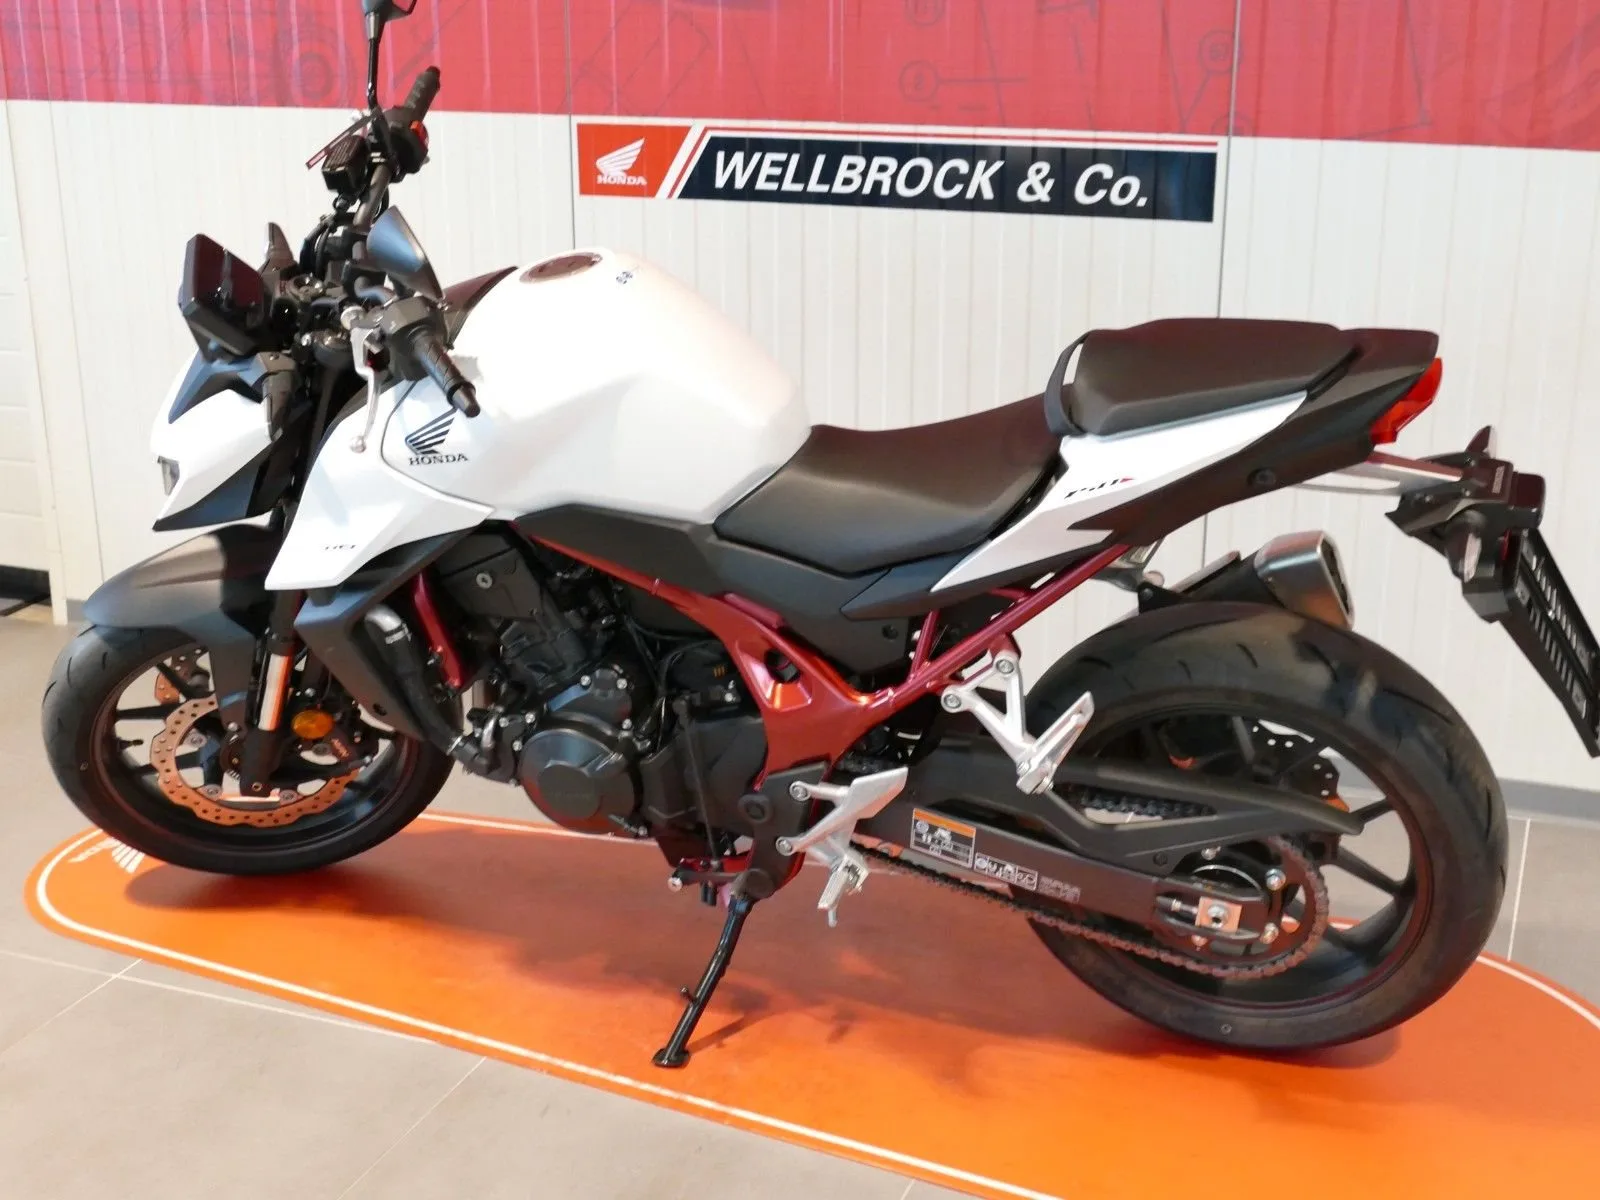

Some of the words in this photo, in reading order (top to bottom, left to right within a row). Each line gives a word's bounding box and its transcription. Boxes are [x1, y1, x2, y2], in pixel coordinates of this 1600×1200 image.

[597, 174, 648, 186] HONDA
[715, 150, 1004, 200] WELLBROCK
[1016, 161, 1055, 203] &
[1074, 163, 1148, 208] Co.
[408, 453, 468, 465] HONDA
